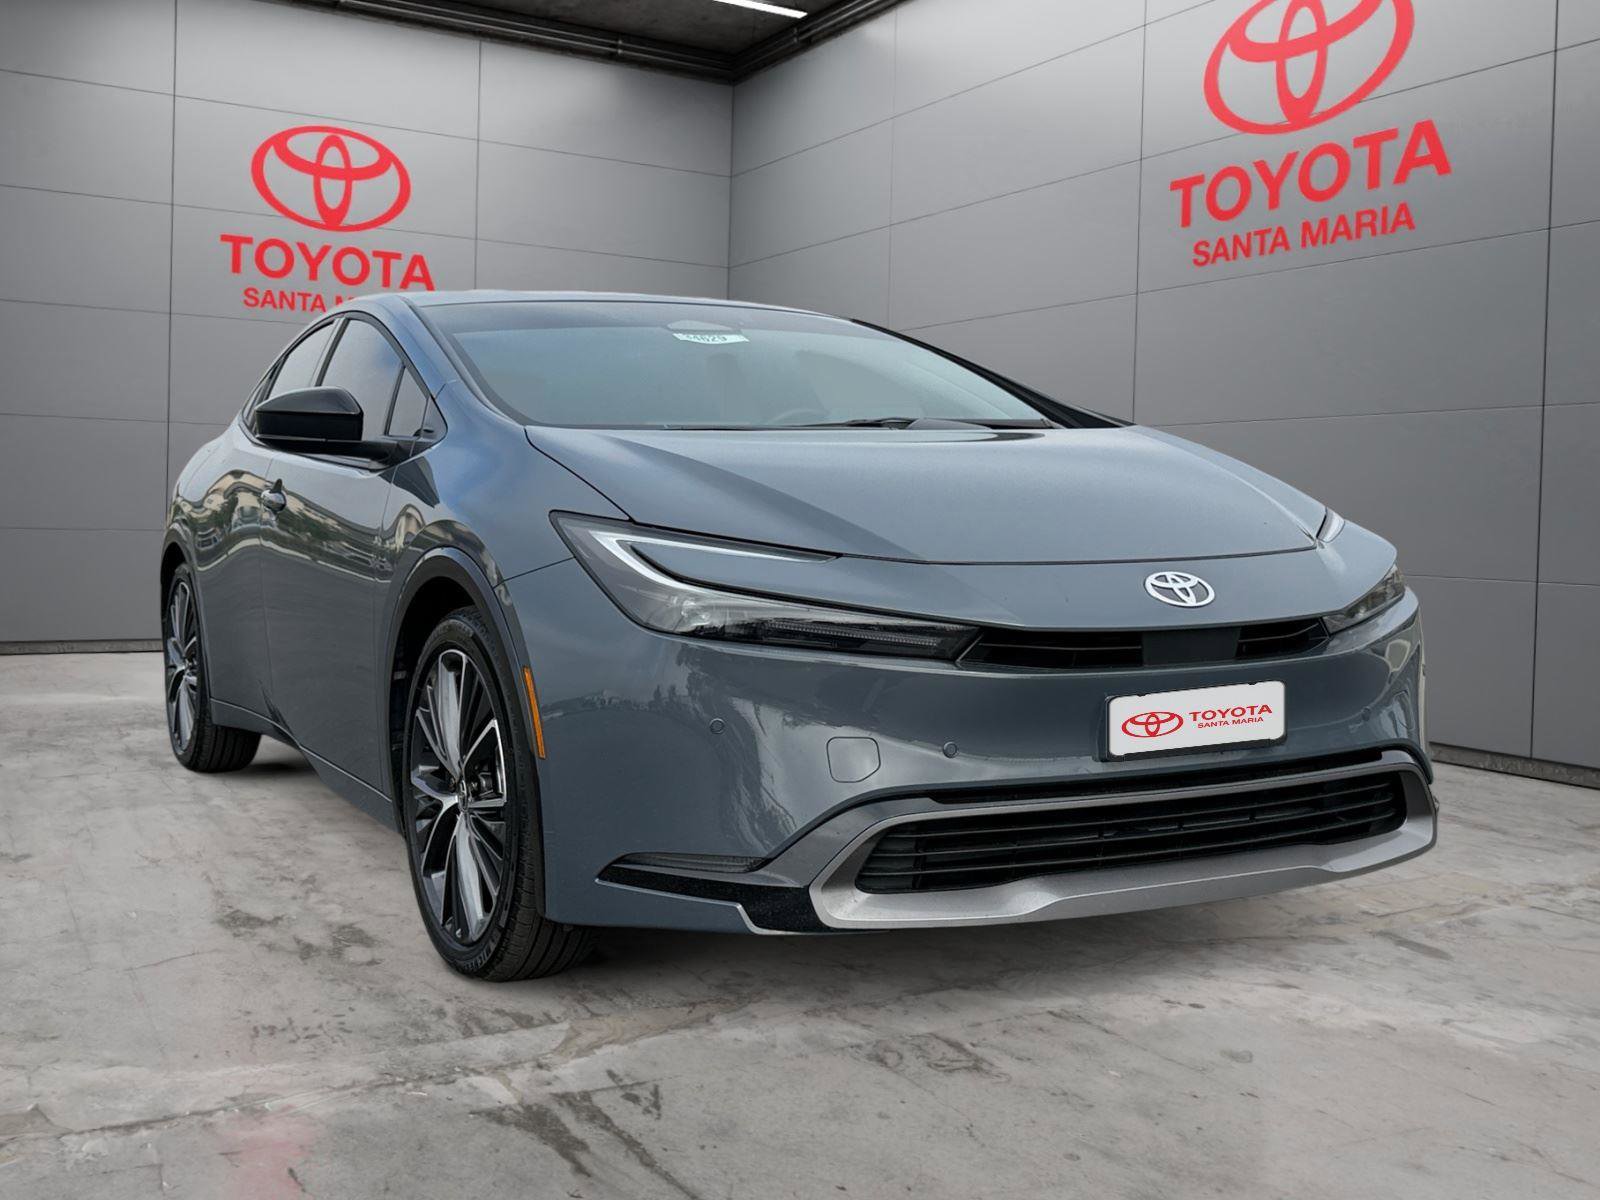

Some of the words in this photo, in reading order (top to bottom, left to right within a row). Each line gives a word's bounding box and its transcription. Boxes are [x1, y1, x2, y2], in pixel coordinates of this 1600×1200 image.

[1168, 118, 1453, 229] TOYOTA
[1192, 225, 1292, 269] SANTA
[1300, 201, 1417, 250] MARIA
[219, 232, 436, 293] TOYOTA
[242, 286, 328, 313] SANTA
[1188, 703, 1274, 722] TOYOTA
[1197, 719, 1230, 729] SANTA
[1231, 715, 1264, 725] MARIA
